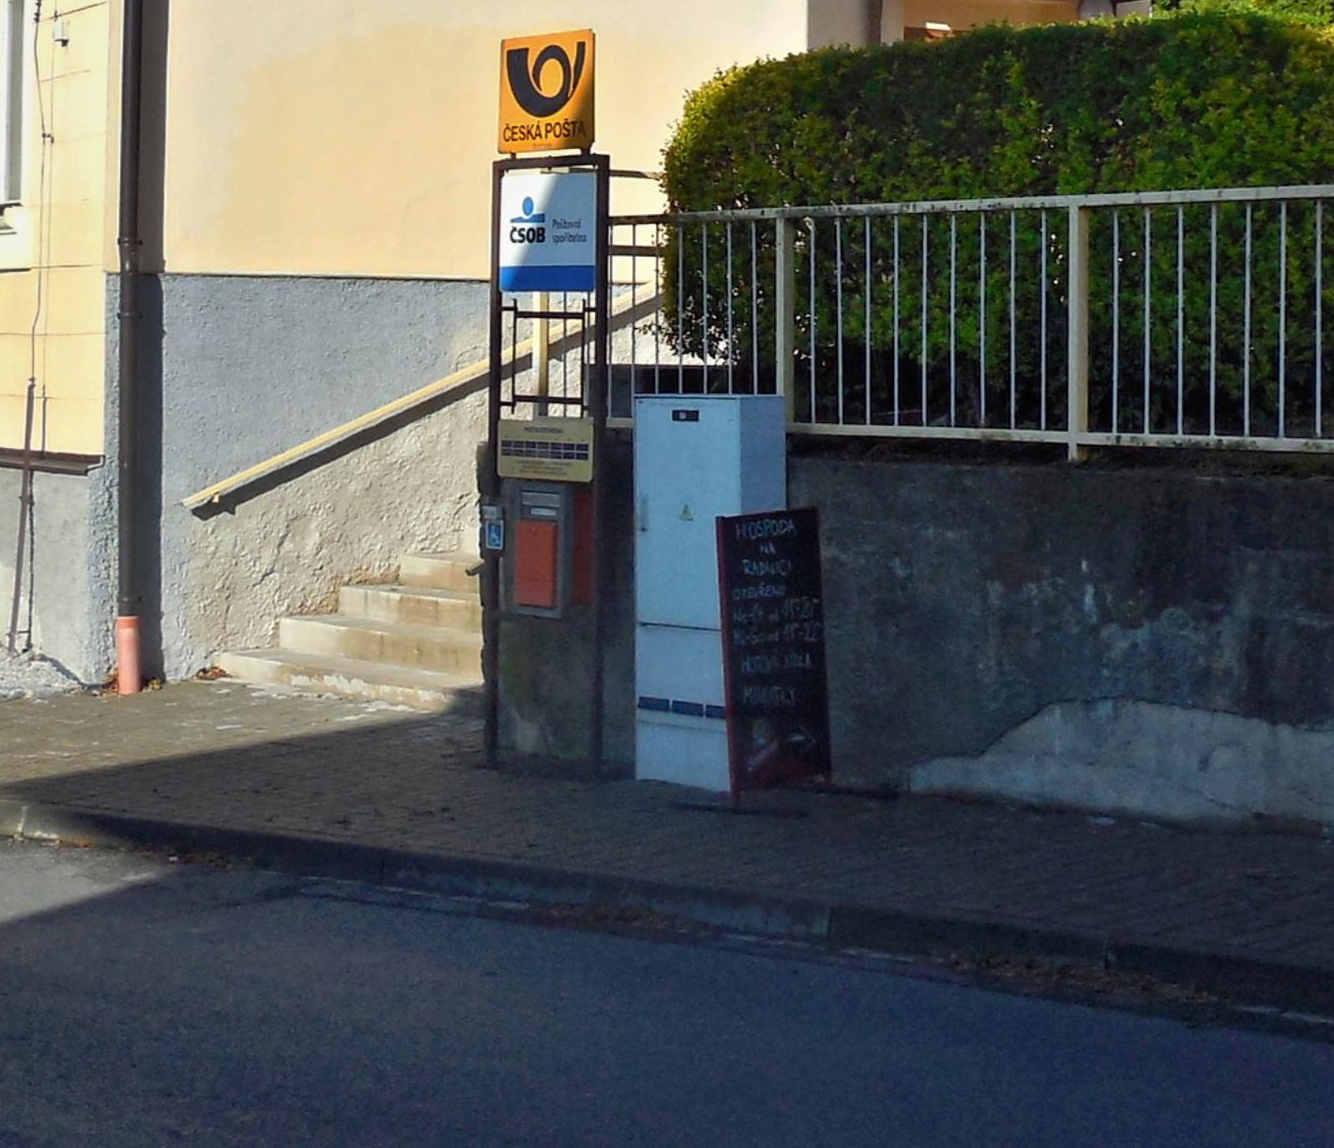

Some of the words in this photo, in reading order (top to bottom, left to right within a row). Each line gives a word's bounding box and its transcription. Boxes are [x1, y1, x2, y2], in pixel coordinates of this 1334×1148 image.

[503, 121, 542, 142] ČESKÁ
[544, 119, 587, 138] POŠTA
[510, 226, 546, 243] ČSOB
[735, 518, 795, 541] HOSPODA
